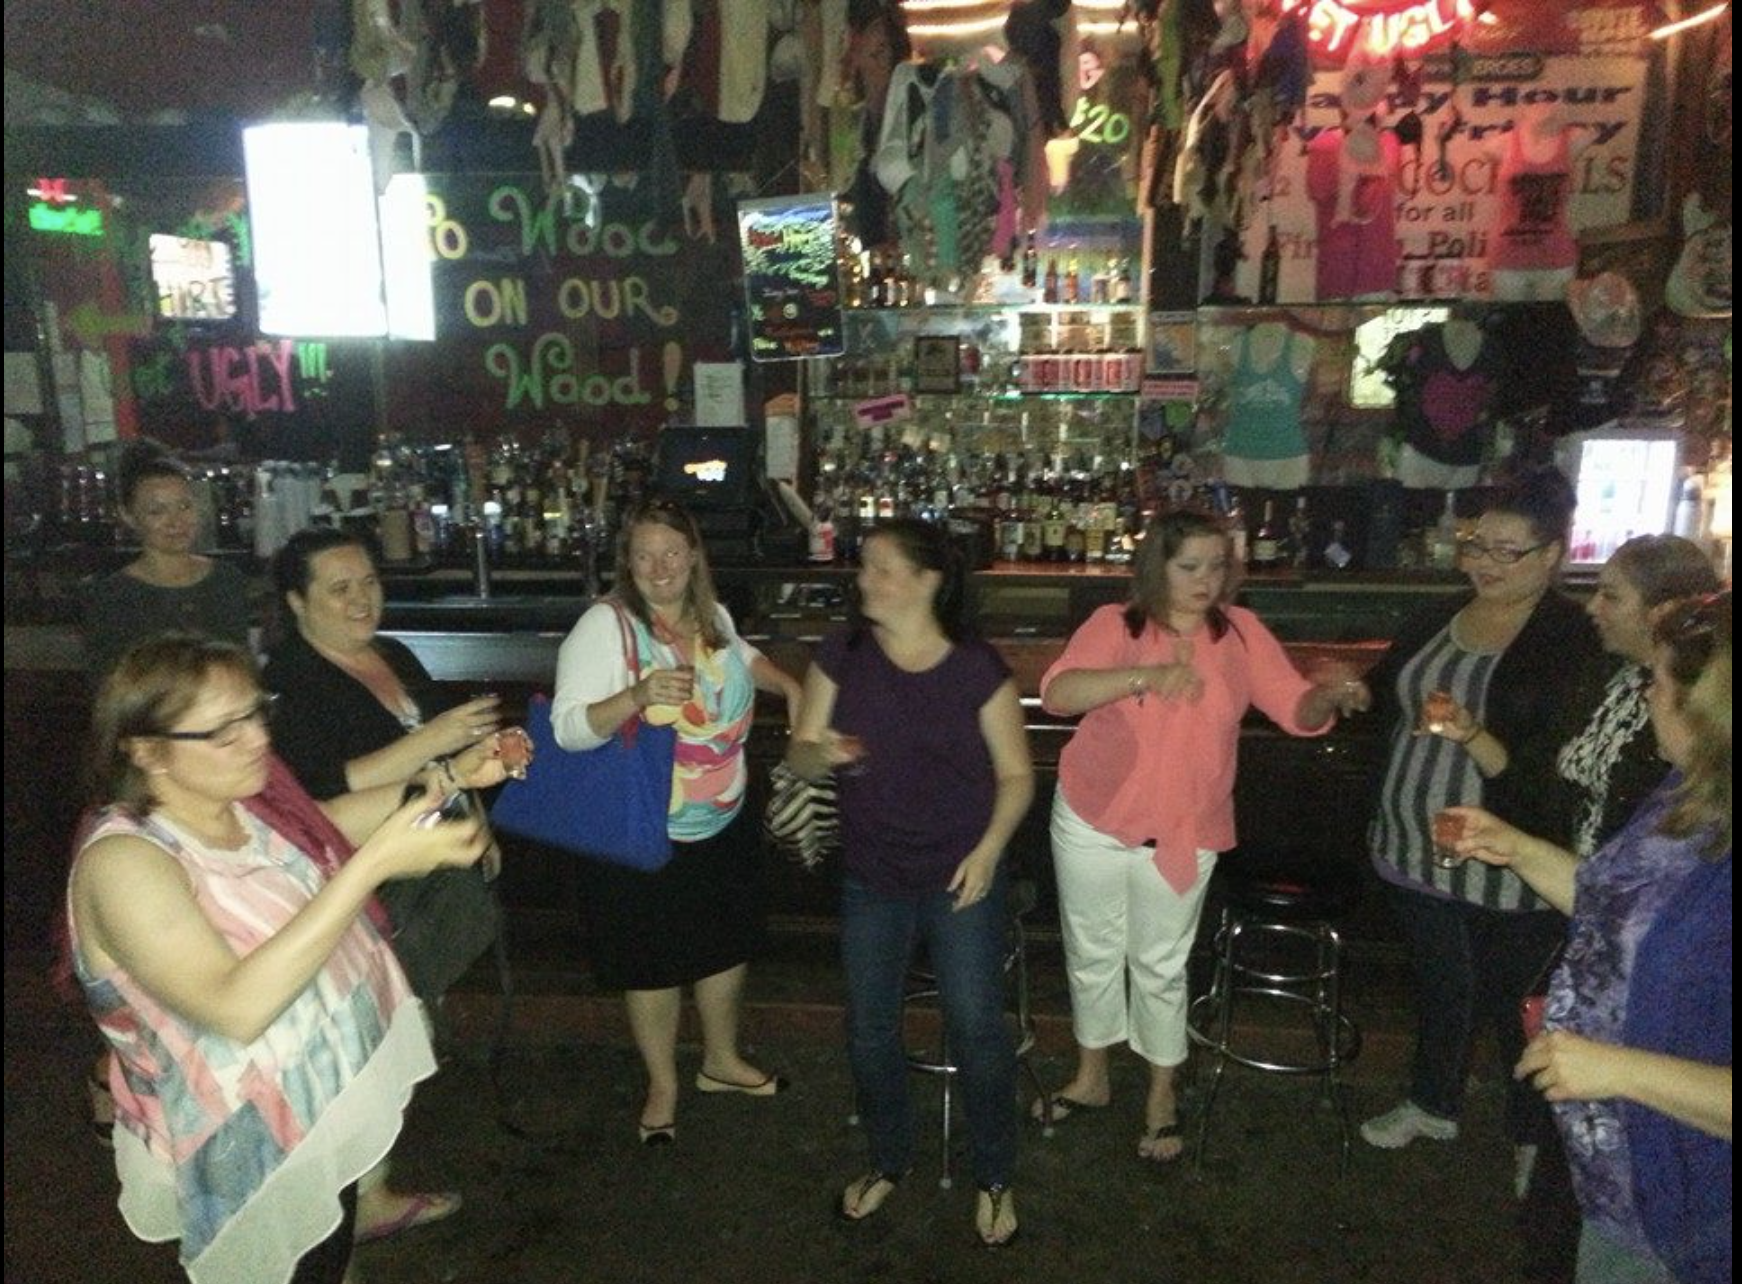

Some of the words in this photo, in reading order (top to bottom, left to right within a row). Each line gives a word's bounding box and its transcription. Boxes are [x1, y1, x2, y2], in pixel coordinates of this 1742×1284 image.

[1472, 87, 1632, 107] Hour
[1443, 202, 1474, 222] all
[464, 277, 527, 328] ON
[558, 276, 680, 327] OUR
